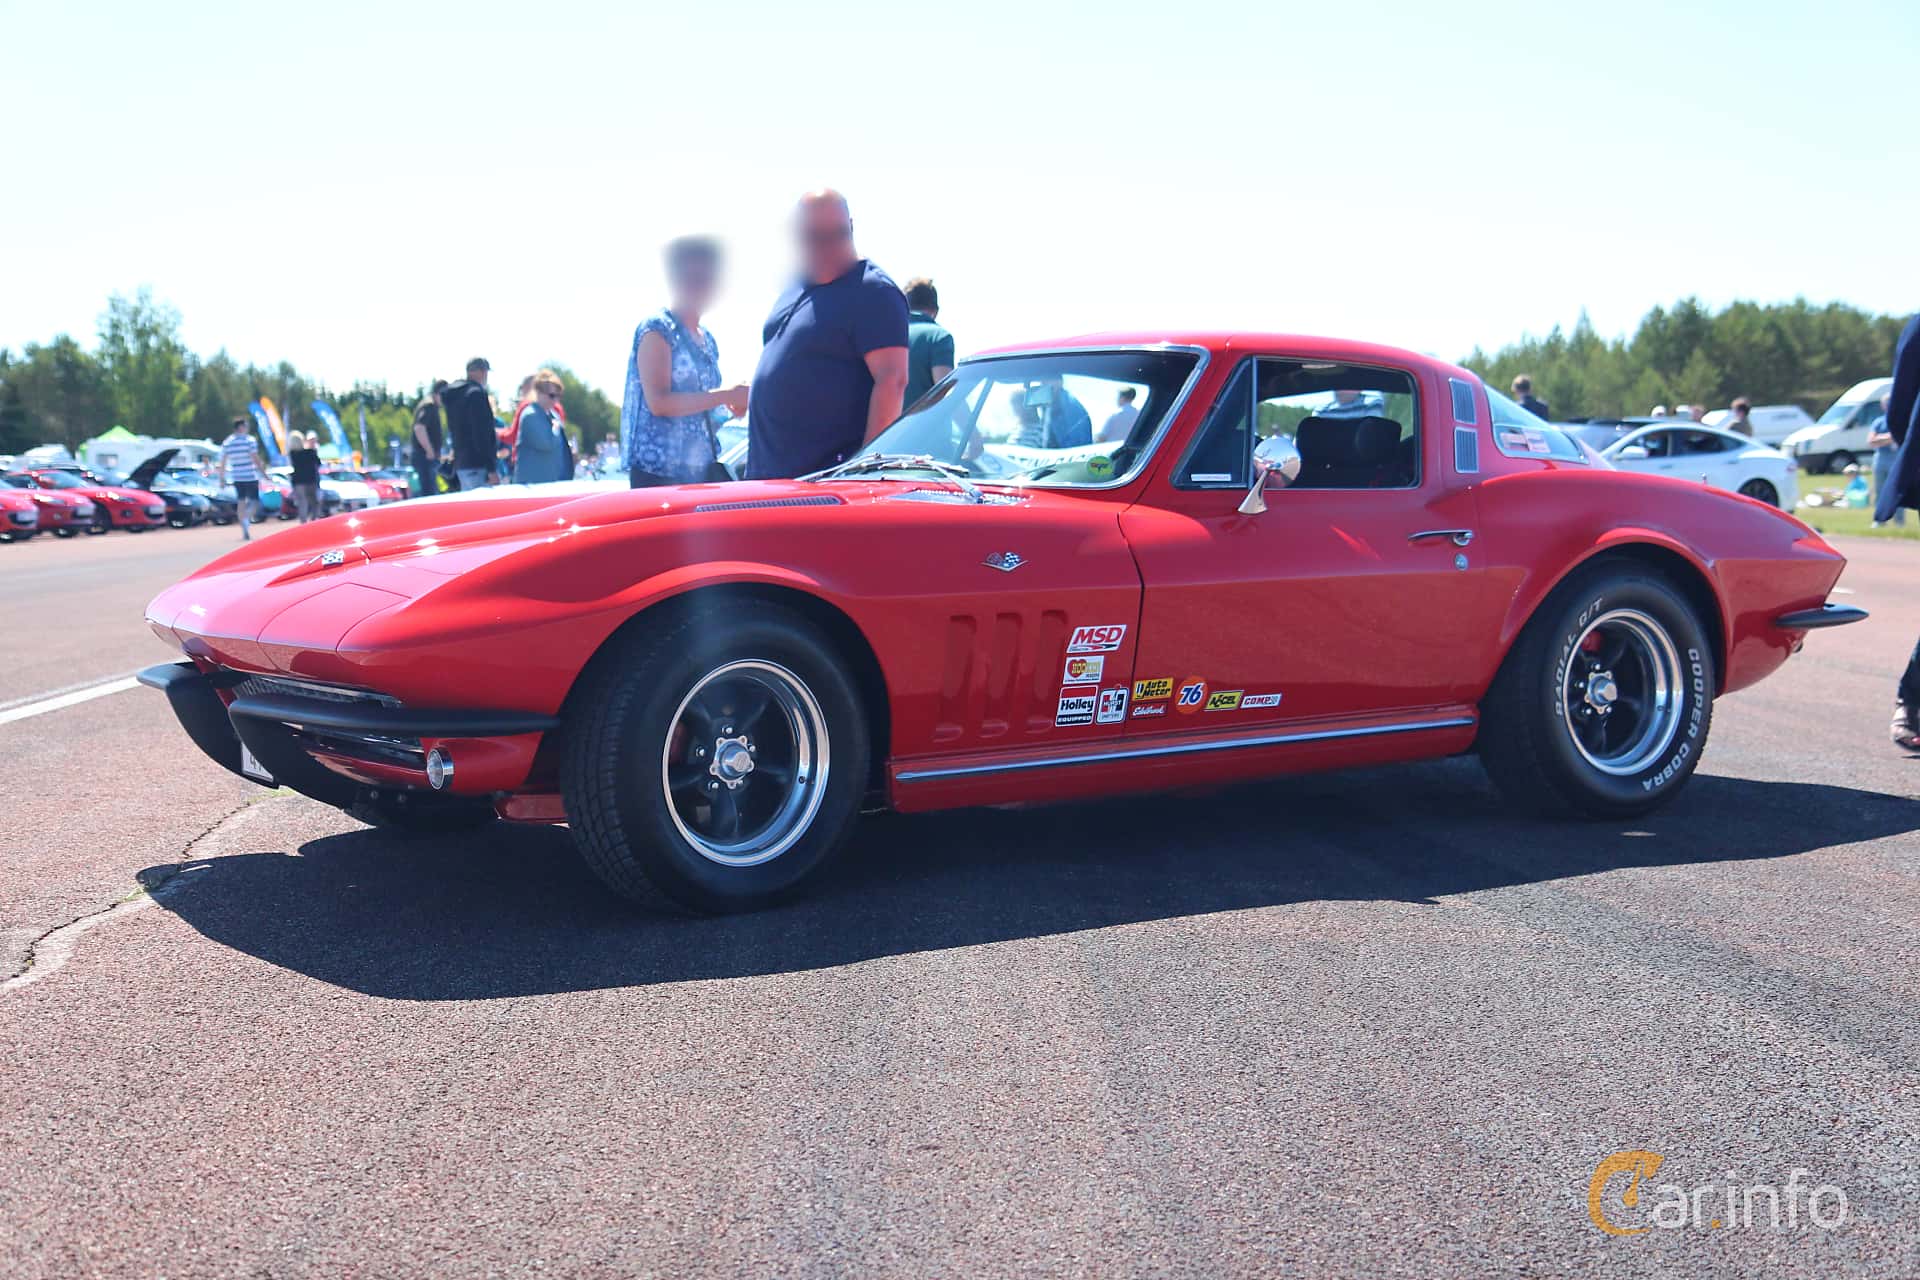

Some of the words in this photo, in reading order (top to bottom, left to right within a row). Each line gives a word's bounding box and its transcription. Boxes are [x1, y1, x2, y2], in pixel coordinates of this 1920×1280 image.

[1073, 627, 1122, 645] MSD
[1144, 687, 1171, 697] Meter
[1145, 680, 1168, 689] Auto
[1178, 682, 1206, 705] 76
[1688, 647, 1704, 739] COOPER
[1060, 699, 1094, 712] Holley
[1057, 715, 1092, 723] EQUIPPED
[1642, 743, 1691, 792] COBRA
